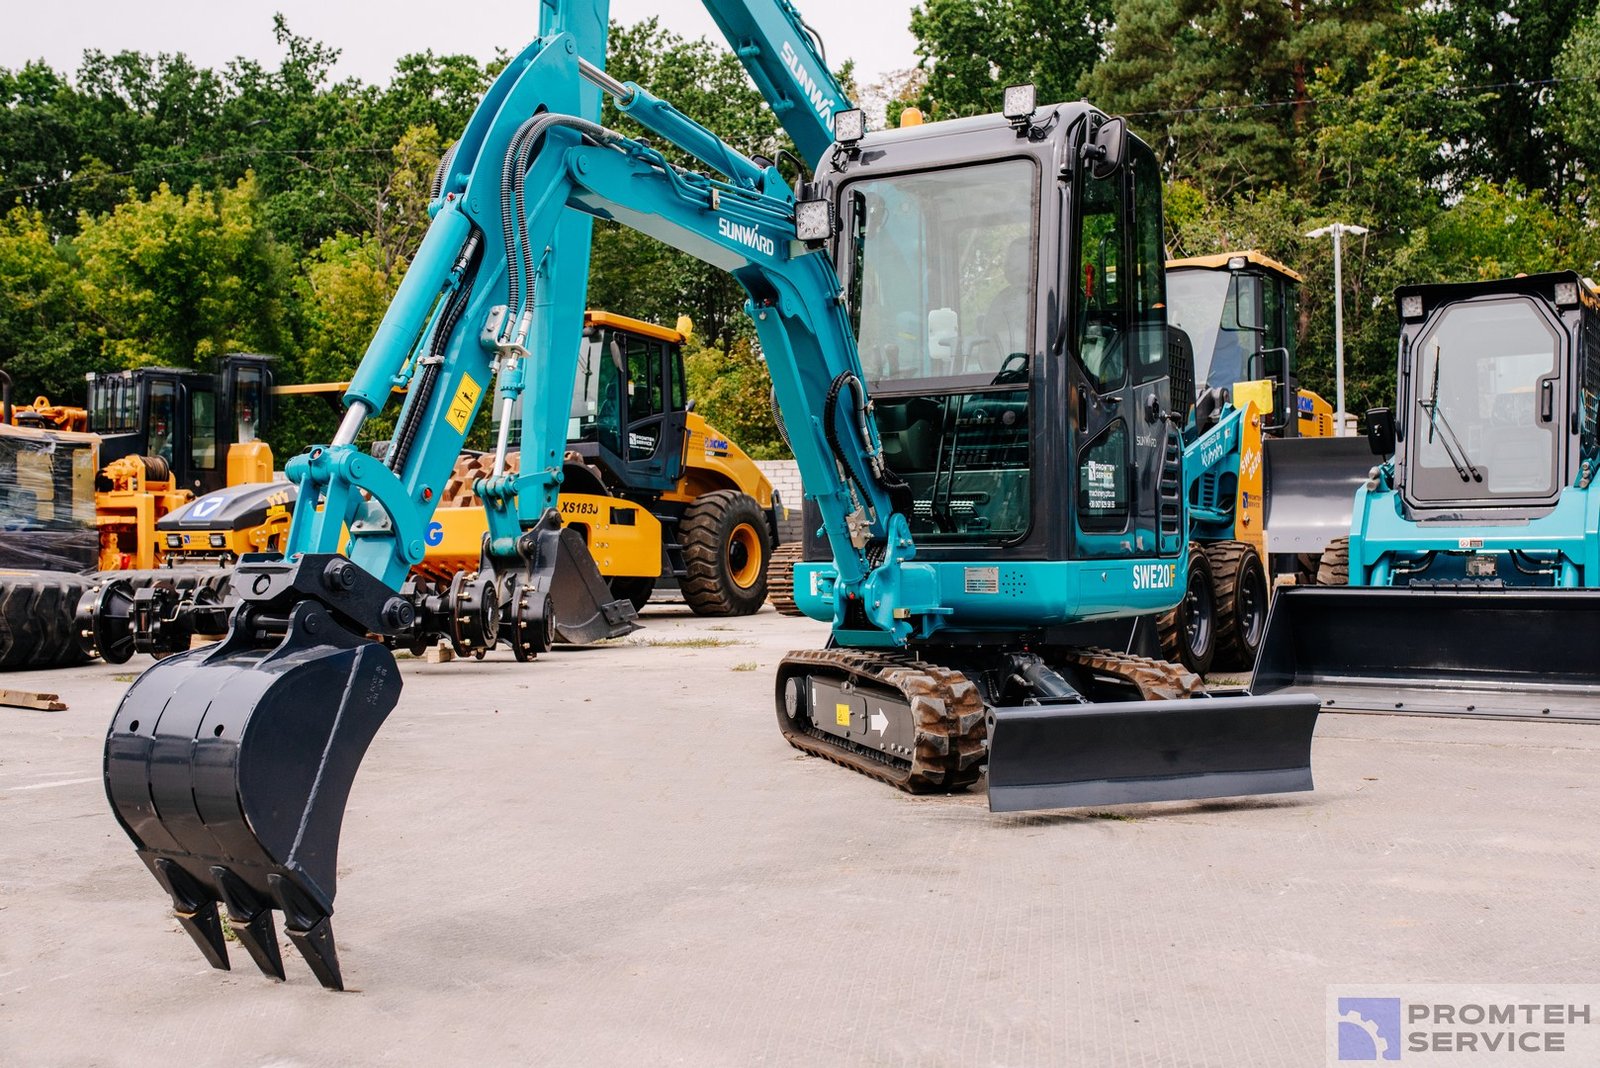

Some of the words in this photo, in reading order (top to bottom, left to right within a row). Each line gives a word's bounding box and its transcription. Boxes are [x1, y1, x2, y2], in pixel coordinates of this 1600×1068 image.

[781, 41, 835, 132] SUNWA
[718, 217, 774, 256] SUNWARD
[561, 501, 599, 515] XS183J
[1132, 564, 1176, 590] SWE20F
